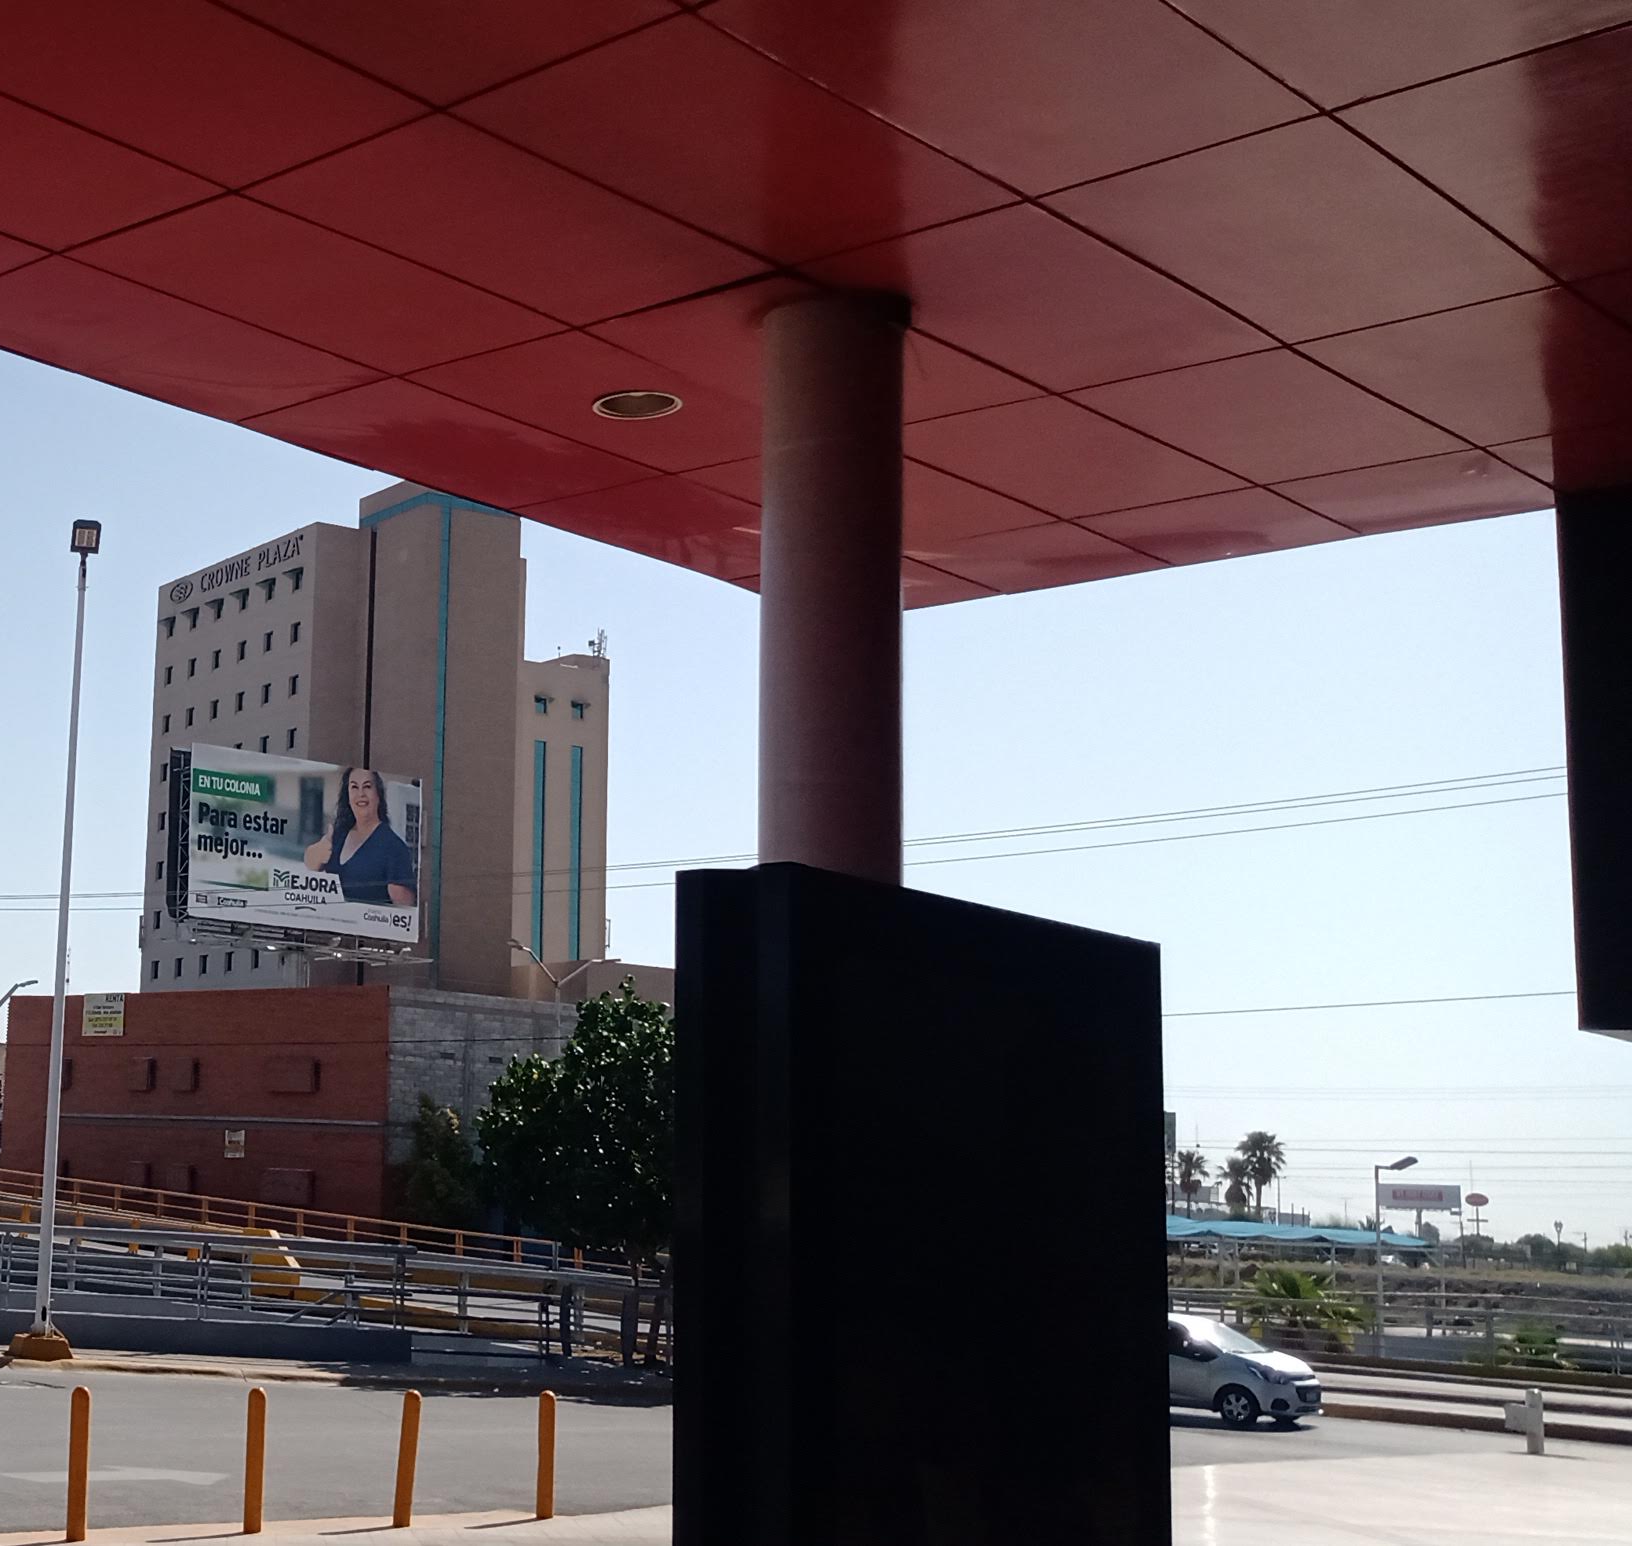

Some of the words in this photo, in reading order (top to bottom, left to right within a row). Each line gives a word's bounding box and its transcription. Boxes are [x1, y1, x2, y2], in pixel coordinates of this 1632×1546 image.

[200, 556, 251, 592] CROWNE
[258, 536, 301, 571] PLAZA
[198, 775, 211, 789] EN
[211, 776, 224, 791] TU
[224, 779, 261, 796] COLONIA
[198, 801, 238, 829] Para
[243, 811, 288, 835] estar
[197, 831, 263, 860] mejor...
[284, 892, 327, 905] COAHUILA
